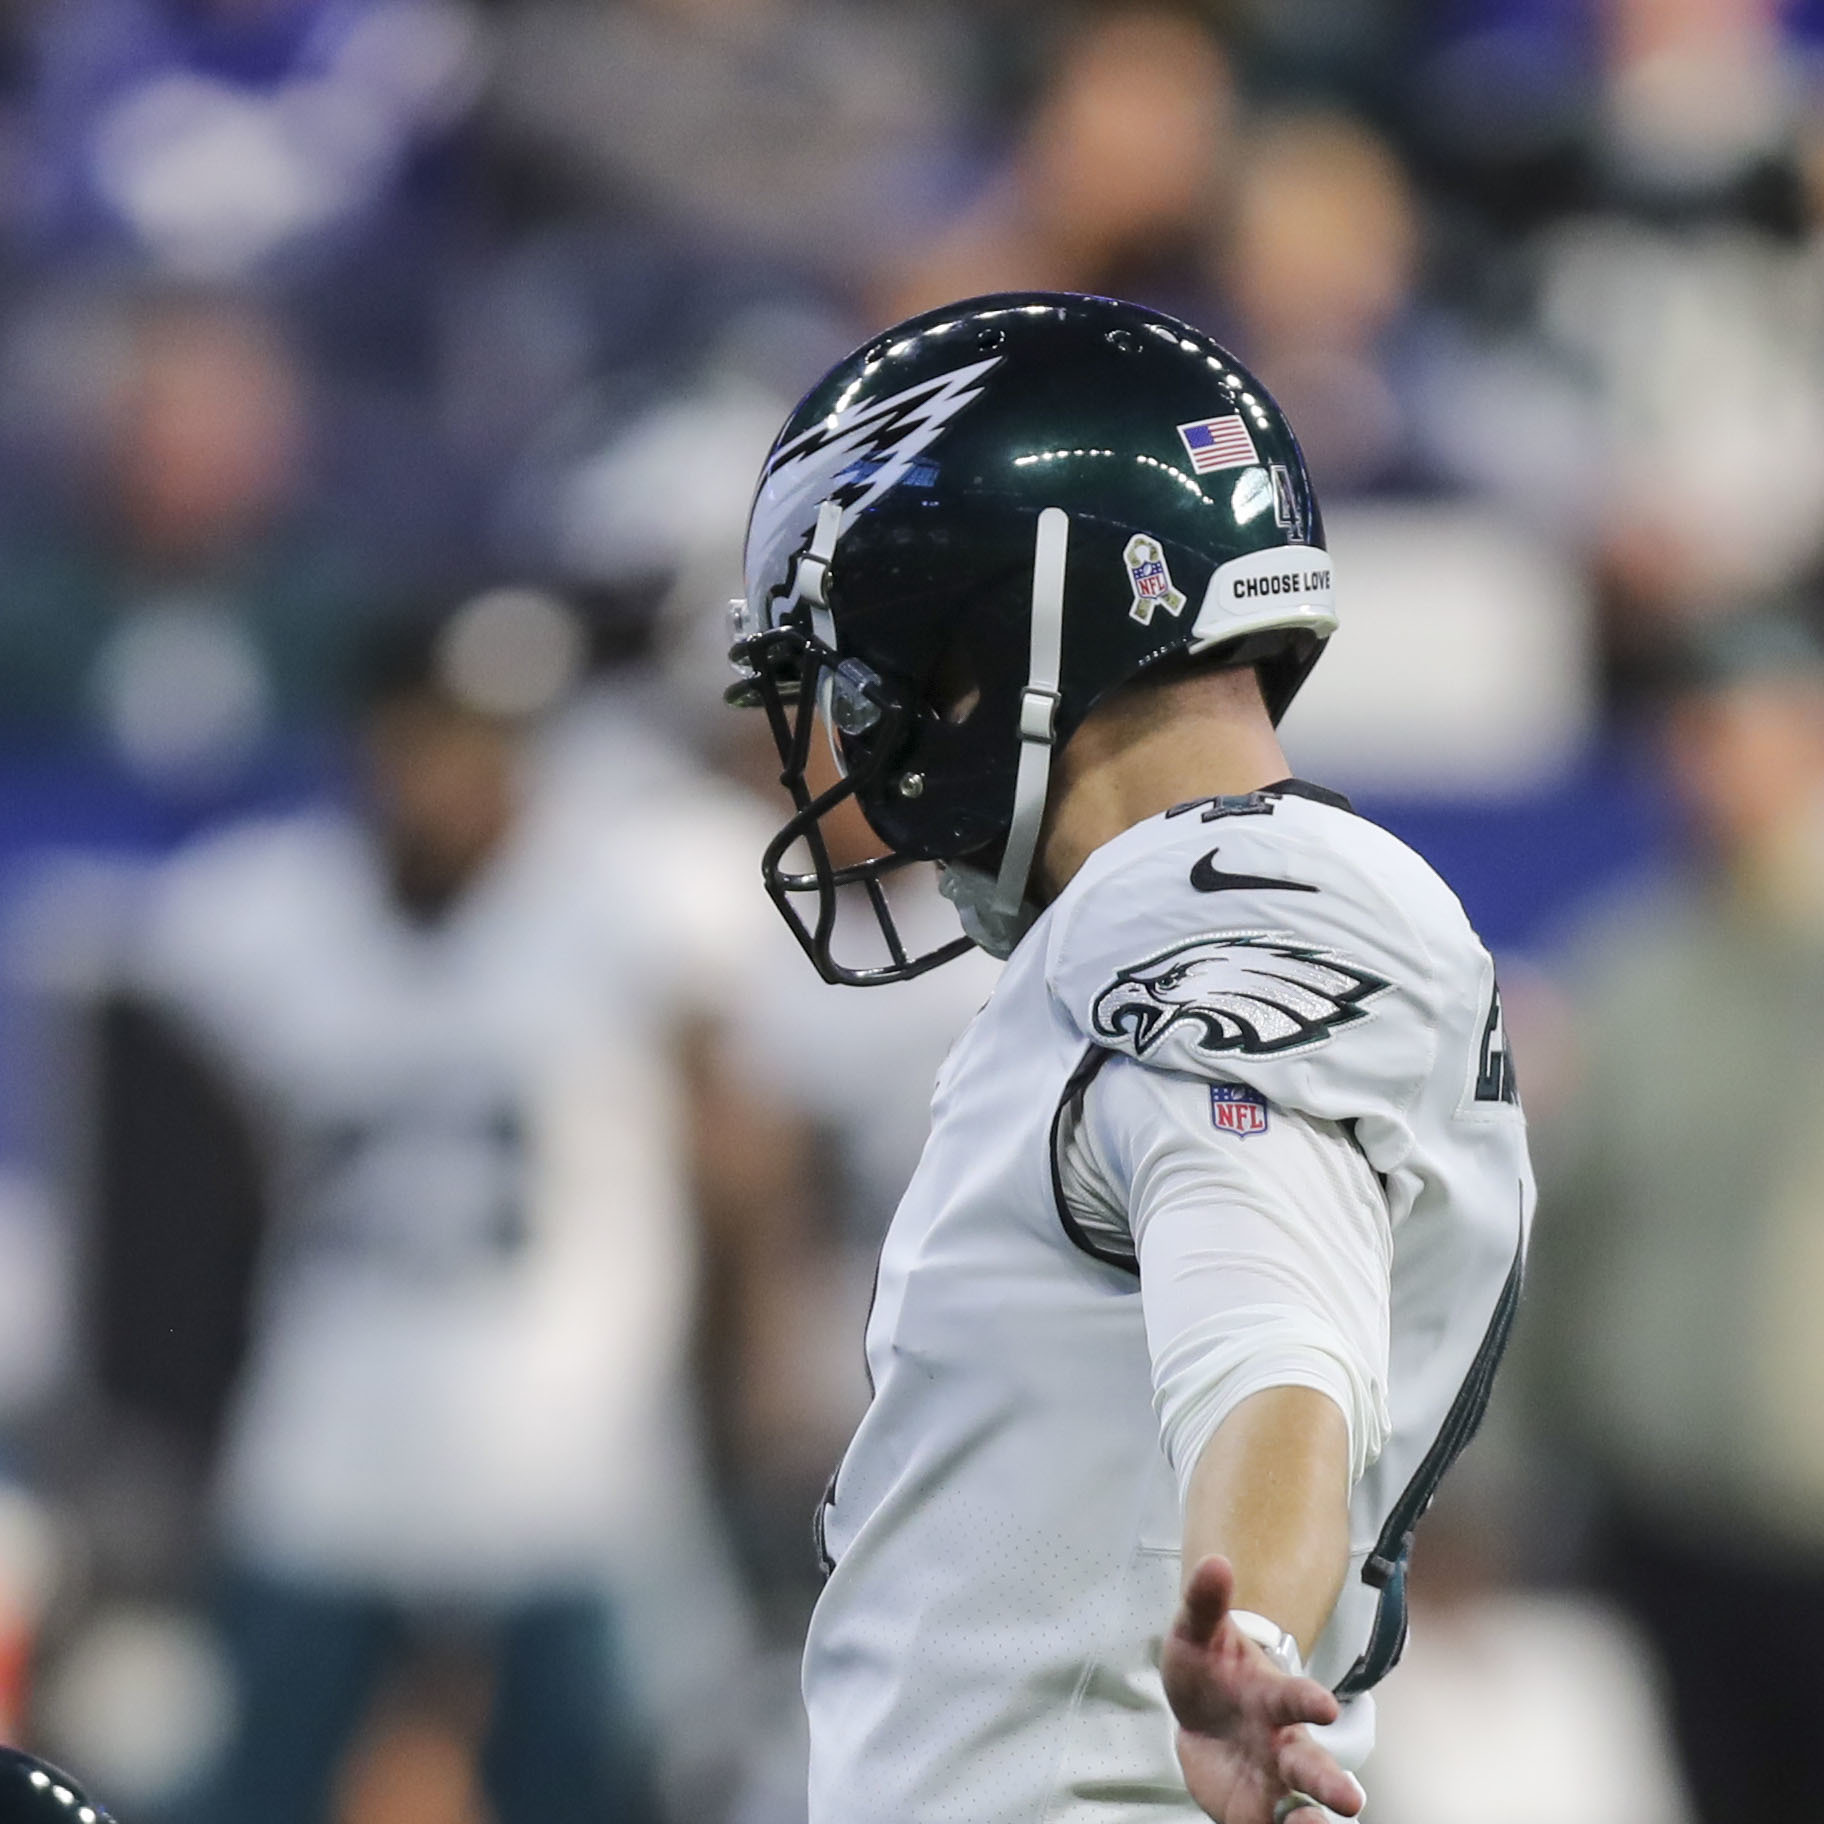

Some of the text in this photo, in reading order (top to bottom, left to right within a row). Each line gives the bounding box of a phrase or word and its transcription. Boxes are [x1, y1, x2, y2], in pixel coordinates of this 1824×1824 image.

[1138, 575, 1166, 597] NFL
[1233, 570, 1330, 598] CHOOSE LOVE
[1216, 1102, 1264, 1130] NFL
